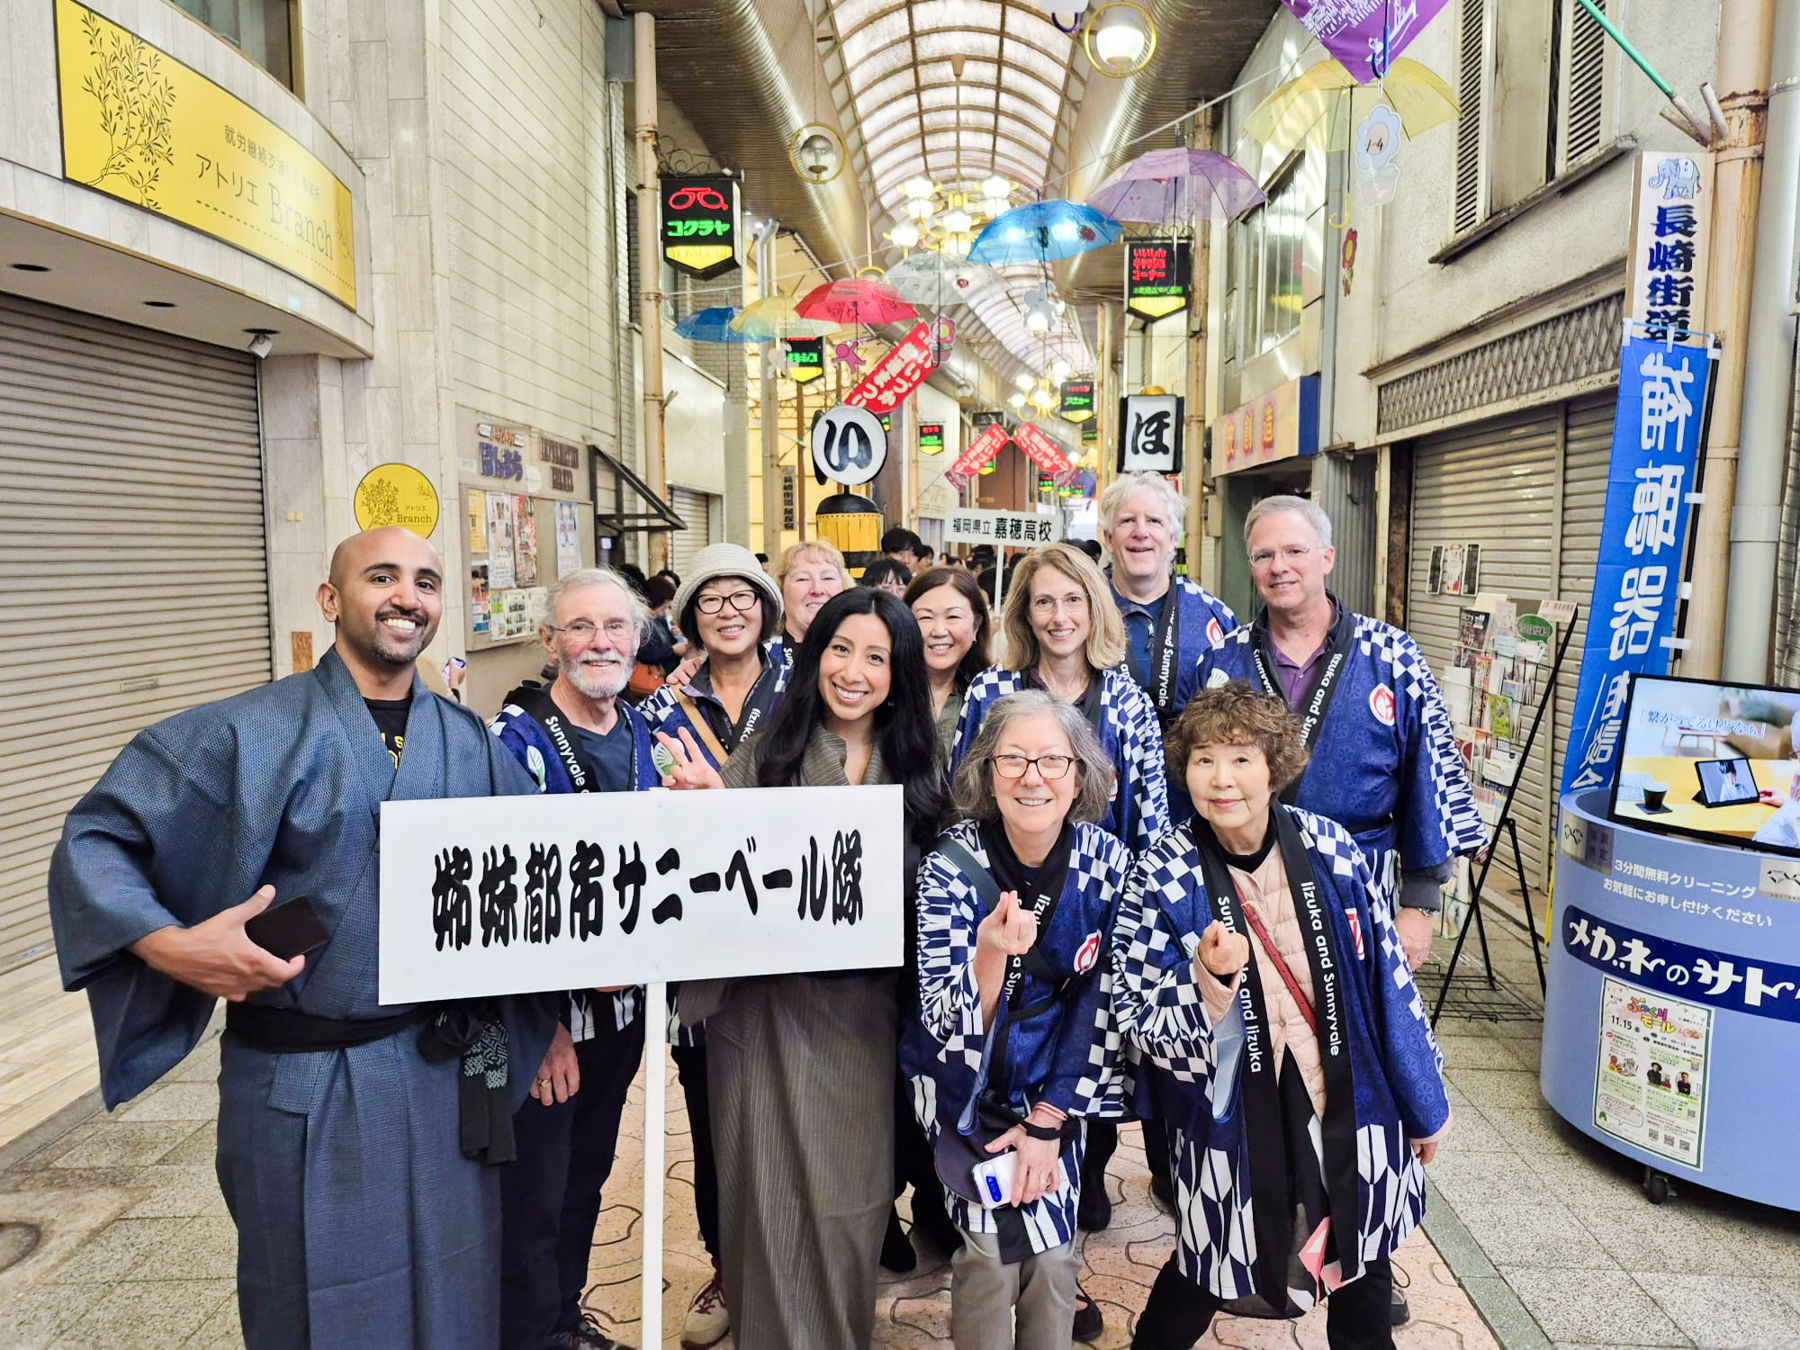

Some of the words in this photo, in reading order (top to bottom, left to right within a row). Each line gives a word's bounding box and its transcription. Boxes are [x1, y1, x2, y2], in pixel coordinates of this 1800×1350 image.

[196, 153, 259, 206] アトリエ
[268, 182, 333, 260] Branch
[667, 219, 730, 237] コクラヤ
[1643, 205, 1697, 342] 長崎街道
[1131, 410, 1171, 455] ほ
[397, 513, 432, 524] Branch
[953, 517, 991, 535] 福岡県立
[994, 517, 1052, 542] 嘉穂高校
[1158, 648, 1174, 707] Sunnyvale
[1321, 653, 1343, 688] Iizuka
[1310, 689, 1326, 716] and
[739, 707, 762, 742] Iizuka
[545, 715, 586, 787] Sunnyvale
[432, 828, 864, 952] 姉妹都市サニーベール隊
[1614, 859, 1758, 899] 3分間無料クリーニング
[1301, 881, 1323, 931] Iizuka
[1602, 877, 1773, 927] お気軽にお申し付けください
[1315, 935, 1334, 969] and
[1569, 918, 1800, 1007] メガネのサト
[1239, 987, 1258, 1021] and
[1323, 973, 1342, 1057] Sunnyvale
[1611, 1015, 1632, 1030] 11.15
[1640, 1013, 1677, 1034] モール
[1246, 1025, 1262, 1073] Iizuka
